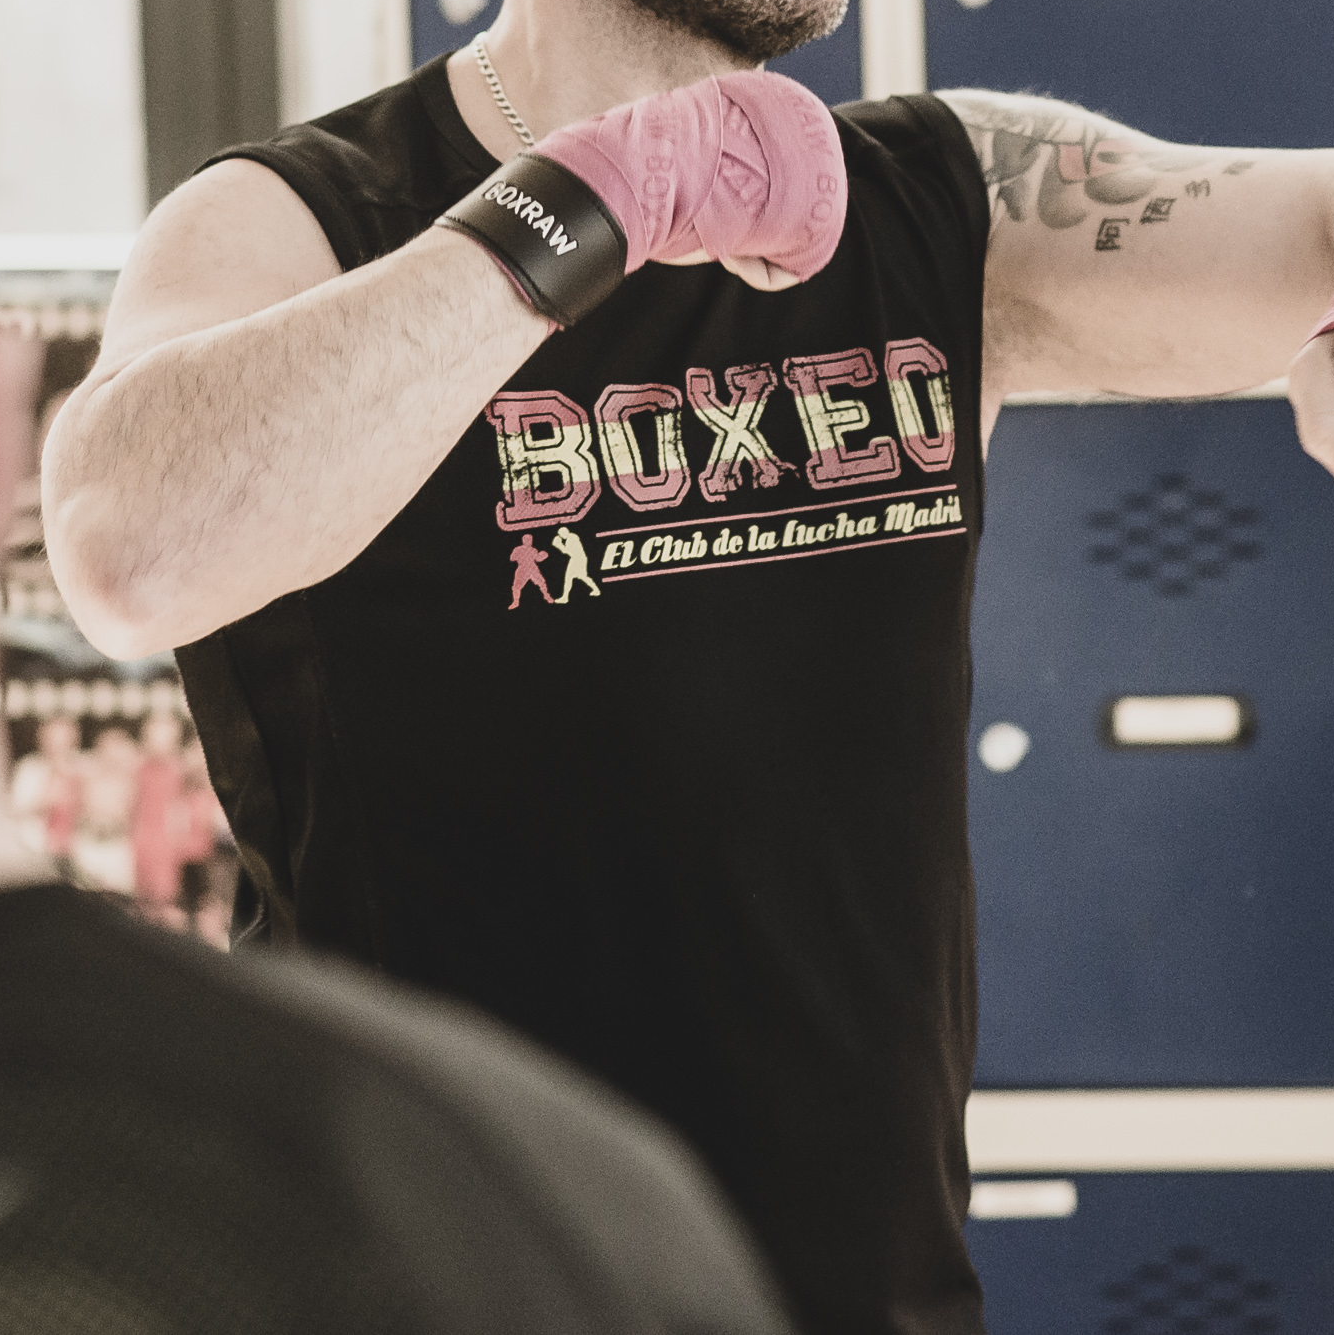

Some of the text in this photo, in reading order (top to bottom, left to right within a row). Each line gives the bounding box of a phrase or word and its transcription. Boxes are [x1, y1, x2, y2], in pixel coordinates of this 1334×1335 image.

[484, 180, 578, 256] BOXRAW
[484, 336, 956, 532] BOXEO
[600, 540, 637, 571] El
[640, 531, 708, 564] Club
[712, 527, 744, 556] de
[747, 525, 781, 552] la
